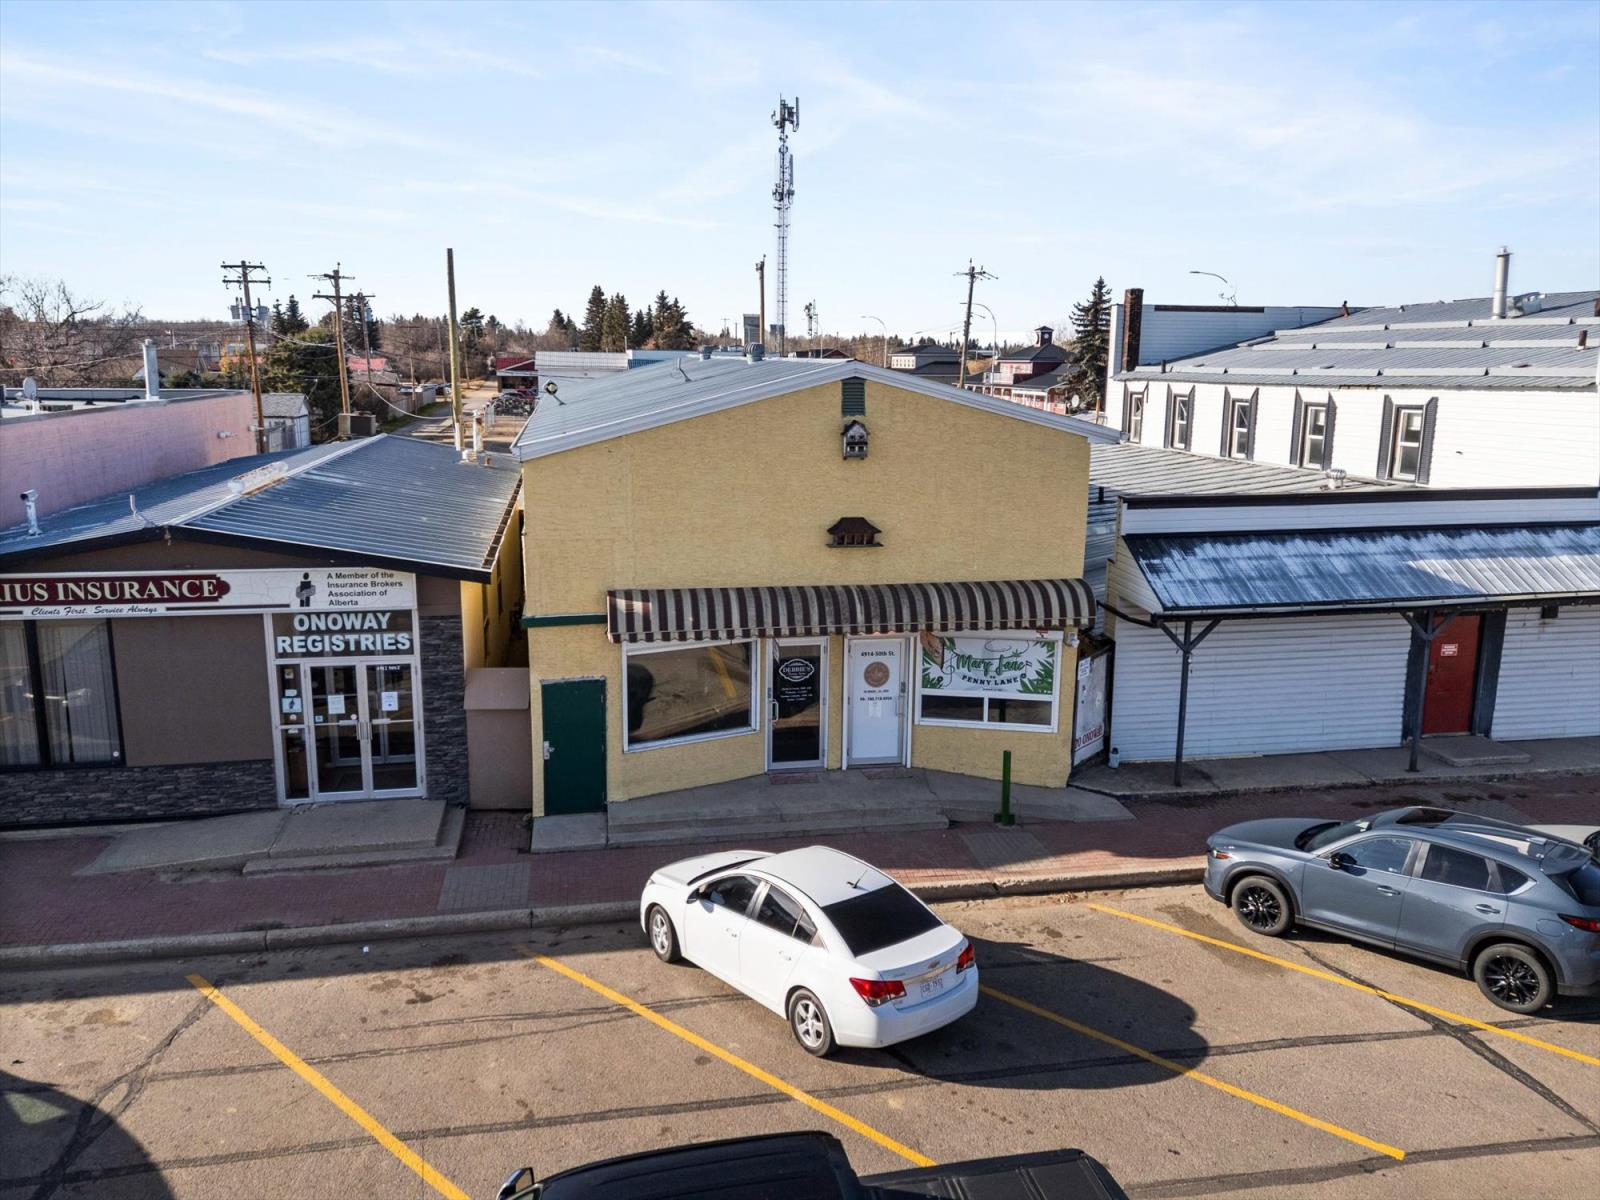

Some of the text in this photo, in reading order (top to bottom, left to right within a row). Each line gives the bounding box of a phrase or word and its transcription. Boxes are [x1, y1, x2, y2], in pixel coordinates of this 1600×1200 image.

[326, 571, 394, 580] A Member of the
[327, 580, 403, 588] Insurance Brokers
[0, 578, 219, 602] IUS INSURANCE
[328, 589, 388, 597] Association of
[328, 599, 359, 607] Alberta
[31, 606, 60, 616] Clients
[93, 605, 123, 615] Service
[126, 605, 157, 615] Always
[293, 612, 391, 632] ONOWAY
[276, 632, 411, 654] REGISTRIES
[961, 674, 1019, 686] PENNY LANE
